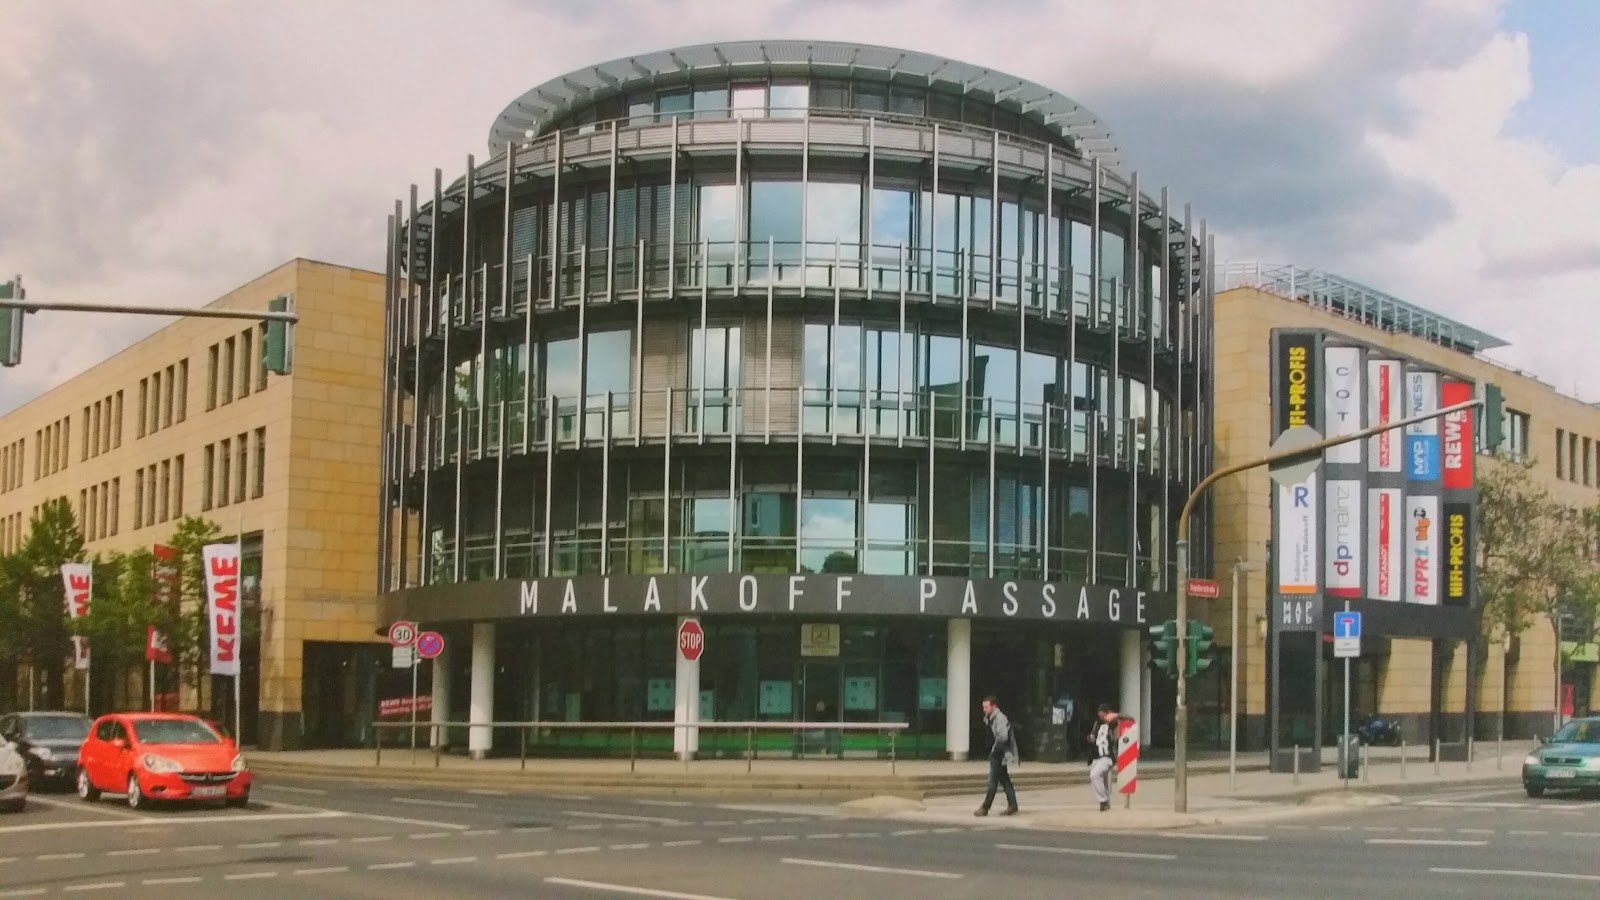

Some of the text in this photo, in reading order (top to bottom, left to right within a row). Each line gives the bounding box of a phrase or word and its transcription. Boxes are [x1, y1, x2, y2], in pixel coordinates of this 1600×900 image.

[1413, 374, 1424, 434] FNESS
[1444, 411, 1462, 469] REWE
[1294, 486, 1309, 508] R
[1334, 486, 1353, 576] dpmainz
[520, 575, 1146, 623] MALAKOFF PASSAGE
[396, 629, 410, 640] 30
[680, 631, 702, 650] STOP
